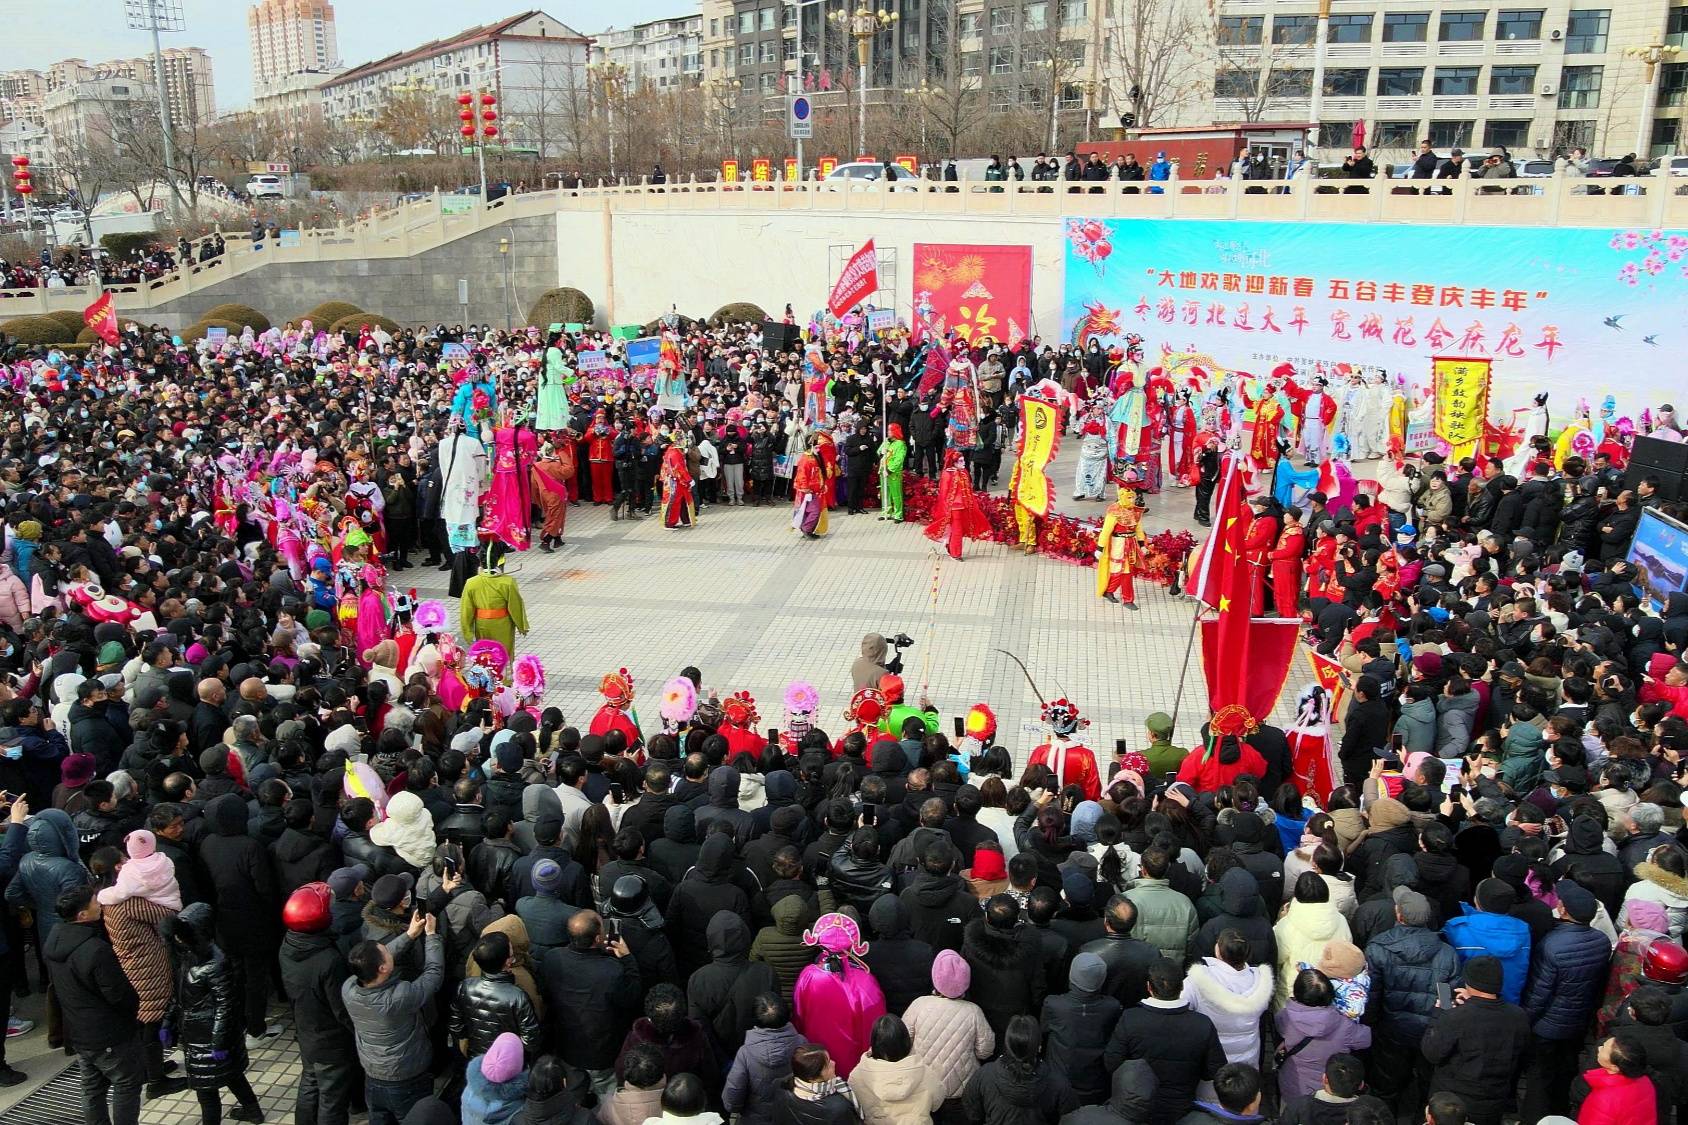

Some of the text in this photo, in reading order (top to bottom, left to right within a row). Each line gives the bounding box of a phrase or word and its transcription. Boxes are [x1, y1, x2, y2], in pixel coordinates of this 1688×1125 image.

[1147, 268, 1548, 311] “大地欢歌迎新春 五谷丰登庆丰年”
[1134, 296, 1310, 336] 冬游河北过大年
